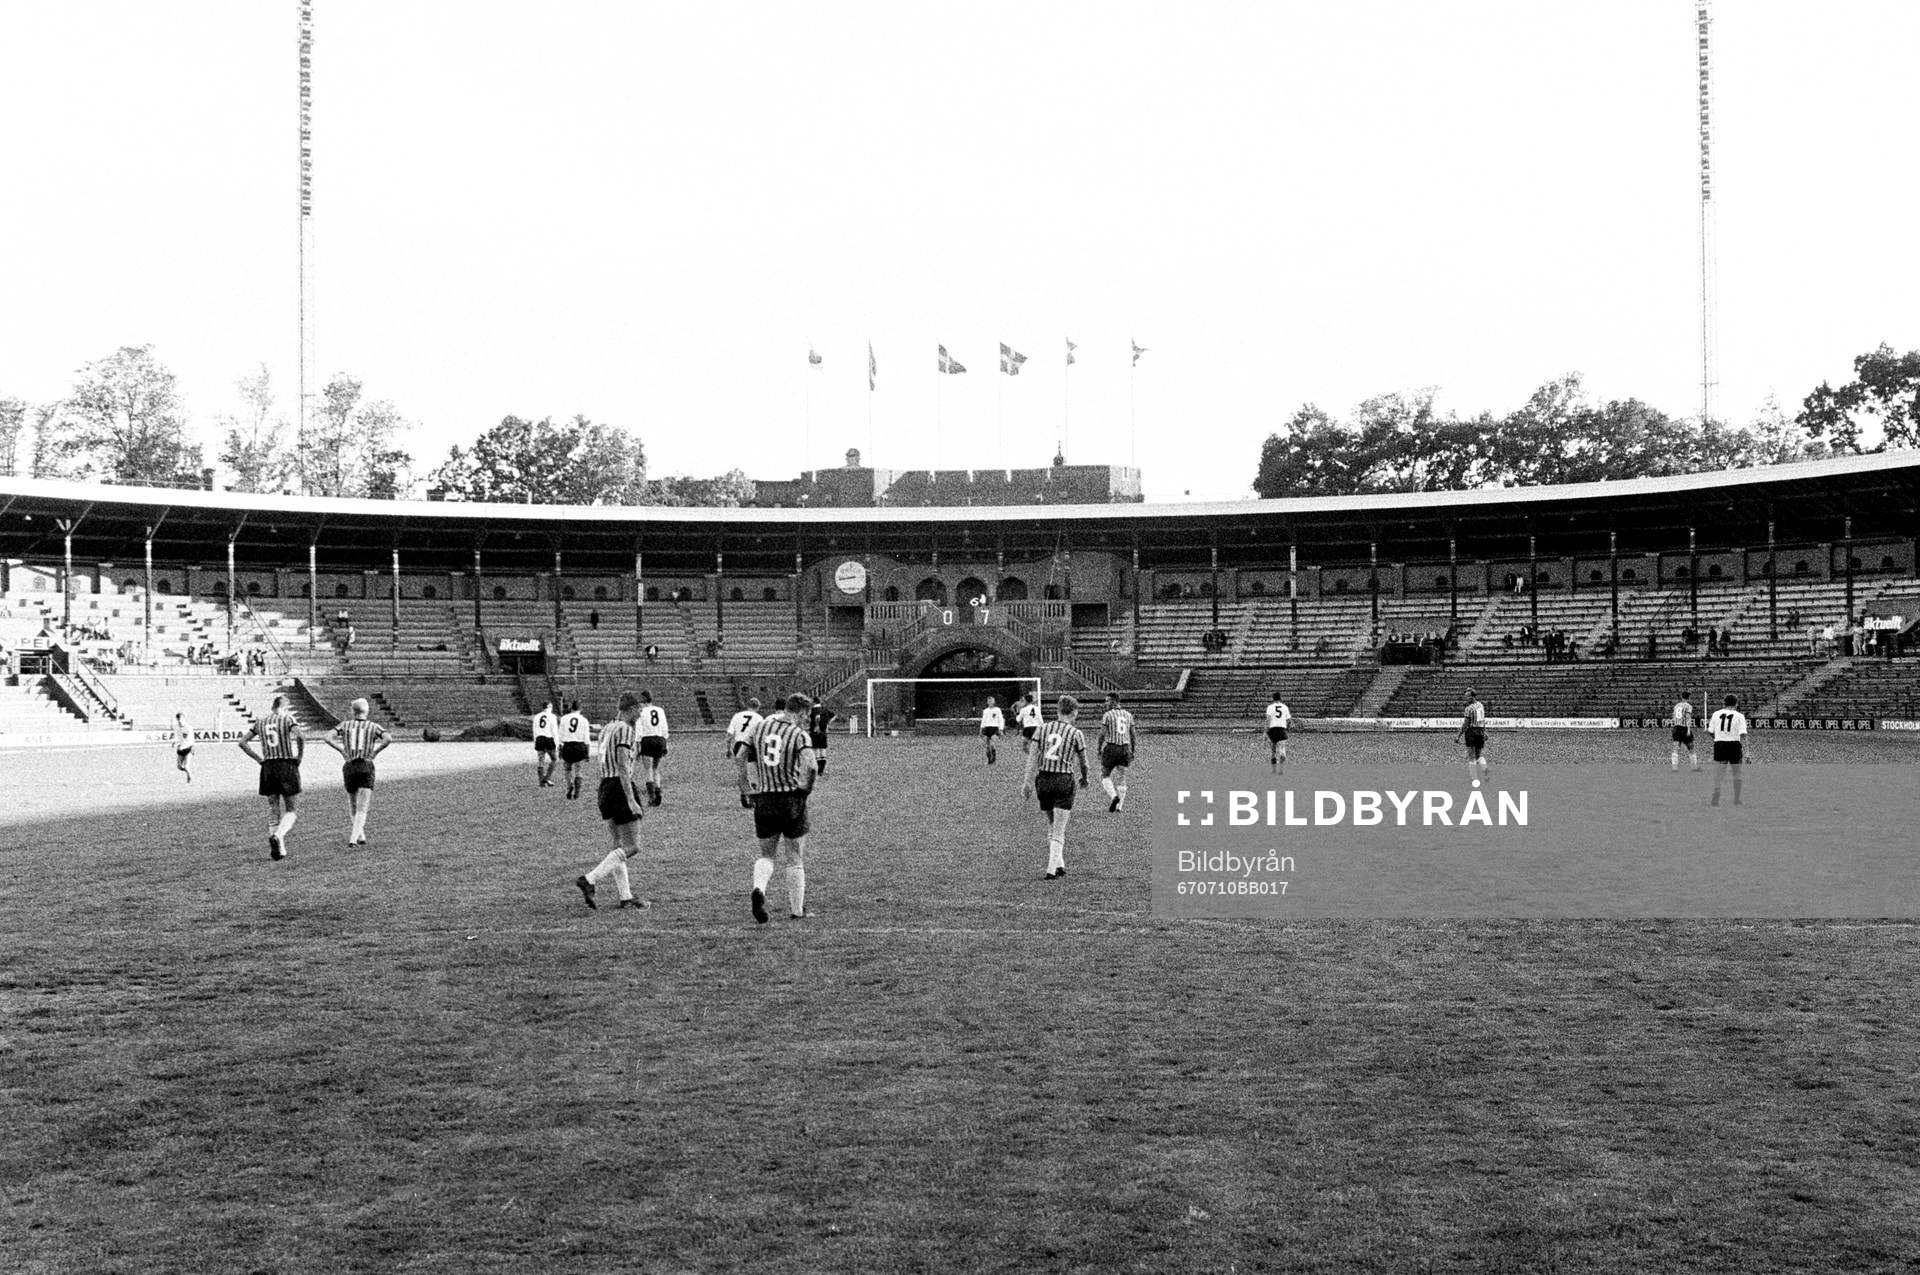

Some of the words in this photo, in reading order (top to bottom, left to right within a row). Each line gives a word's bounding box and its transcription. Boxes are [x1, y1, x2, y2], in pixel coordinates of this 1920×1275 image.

[650, 709, 659, 726] 8
[1029, 707, 1036, 719] 4
[1275, 705, 1282, 718] 5
[539, 715, 547, 728] 6
[568, 717, 578, 733] 9
[741, 715, 752, 732] 7
[1116, 716, 1126, 734] 6
[1719, 713, 1734, 732] 11
[193, 731, 243, 740] KANDIA
[265, 722, 279, 747] 5
[763, 733, 782, 766] 3
[1045, 733, 1062, 760] 2
